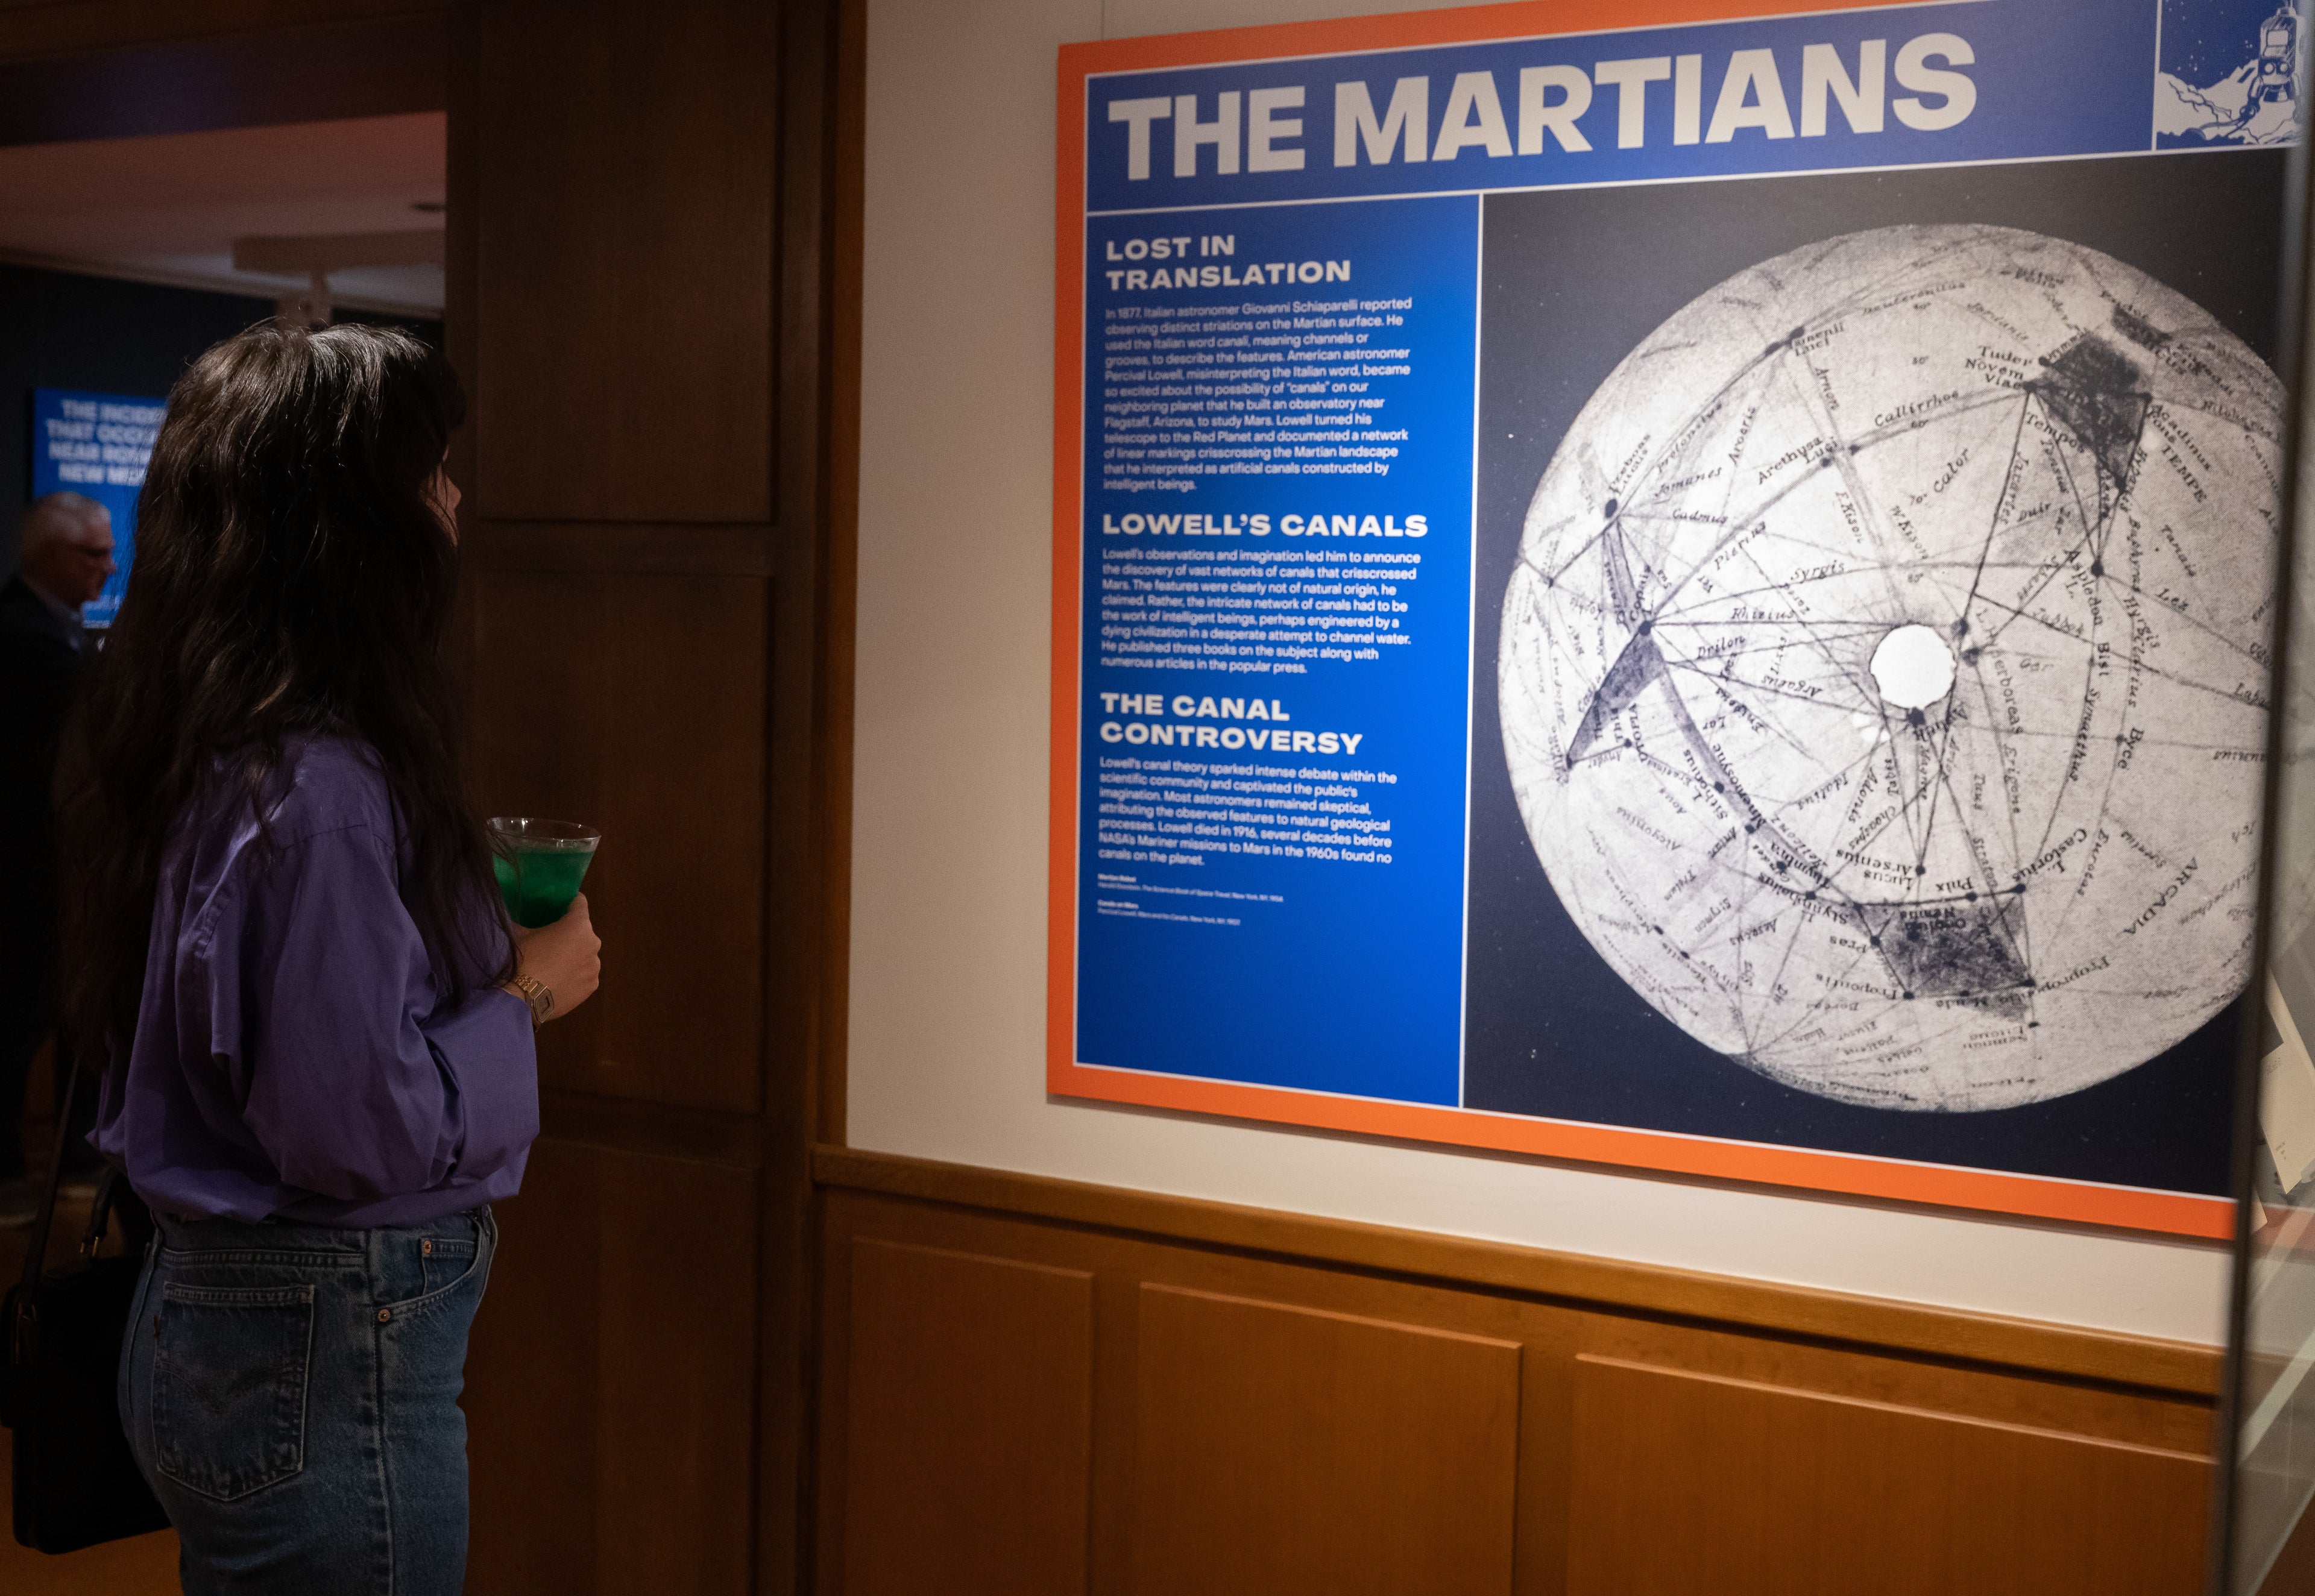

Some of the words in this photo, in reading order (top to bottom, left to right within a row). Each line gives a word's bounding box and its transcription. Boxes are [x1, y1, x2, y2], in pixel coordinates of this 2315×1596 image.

[1109, 86, 1306, 181] THE
[1334, 33, 1977, 169] MARTIANS
[1106, 236, 1191, 262] LOST
[1200, 234, 1235, 257] IN
[1106, 260, 1351, 291] TRANSLATION
[1292, 298, 1358, 315] Schiaparelli
[1359, 297, 1413, 313] reported
[1293, 316, 1337, 329] Martian
[1385, 313, 1404, 326] He
[1302, 331, 1355, 345] channels
[1287, 348, 1342, 362] American
[1341, 347, 1411, 360] astronomer
[1271, 366, 1292, 378] the
[1292, 365, 1328, 378] Italian
[1361, 363, 1411, 376] became
[1331, 382, 1348, 393] on
[1347, 382, 1369, 392] our
[1287, 397, 1358, 412] observatory
[1358, 398, 1385, 409] near
[1275, 413, 1313, 426] Lowell
[1313, 412, 1353, 425] turned
[1353, 412, 1373, 424] his
[1276, 429, 1350, 442] documented
[1360, 429, 1409, 441] network
[1272, 445, 1293, 457] the
[1293, 445, 1338, 457] Martian
[1338, 445, 1399, 459] landscape
[1264, 462, 1301, 473] canals
[1301, 461, 1373, 473] constructed
[1373, 461, 1390, 476] by
[2161, 445, 2206, 503] TEMPE
[1672, 509, 1728, 524] Cadmus
[1103, 514, 1271, 536] LOWELL'S
[1280, 515, 1428, 538] CANALS
[1238, 549, 1304, 564] imagination
[1305, 550, 1324, 562] led
[1324, 550, 1347, 562] him
[1348, 550, 1362, 562] to
[1362, 553, 1421, 564] announce
[1212, 564, 1264, 577] networks
[1264, 565, 1277, 577] of
[1278, 565, 1315, 577] canals
[1316, 566, 1340, 578] that
[1341, 567, 1417, 579] crisscrossed
[1229, 580, 1267, 595] clearly
[1267, 581, 1287, 593] not
[1288, 582, 1302, 594] of
[1302, 582, 1342, 594] natural
[1381, 583, 1397, 595] he
[1206, 595, 1253, 608] intricate
[1253, 596, 1300, 609] network
[1300, 597, 1314, 609] of
[1314, 598, 1352, 610] canals
[1352, 598, 1376, 611] had
[1376, 599, 1390, 611] to
[1391, 599, 1408, 612] be
[1258, 612, 1306, 627] perhaps
[1306, 614, 1374, 629] engineered
[1375, 615, 1391, 630] by
[1209, 627, 1267, 642] desperate
[1267, 628, 1313, 644] attempt
[1314, 630, 1328, 642] to
[1328, 630, 1375, 643] channel
[1238, 645, 1254, 655] on
[1255, 644, 1274, 656] the
[1275, 644, 1318, 660] subject
[1319, 646, 1352, 661] along
[1353, 647, 1379, 659] with
[1699, 636, 1745, 658] Drilon
[1228, 659, 1271, 674] popular
[1101, 692, 1164, 715] THE
[1171, 695, 1290, 721] CANAL
[1100, 721, 1362, 755] CONTROVERSY
[1630, 703, 1648, 762] UTOPIA
[2117, 727, 2143, 770] Byce
[1172, 759, 1208, 775] theory
[1209, 761, 1254, 778] sparked
[1255, 764, 1297, 778] intense
[1297, 766, 1340, 780] debate
[1340, 768, 1376, 782] within
[1377, 770, 1397, 783] the
[1210, 777, 1232, 790] and
[1232, 778, 1292, 795] captivated
[1293, 781, 1313, 794] the
[1848, 768, 1879, 822] Adonis
[1192, 791, 1262, 807] astronomers
[1263, 796, 1317, 810] remained
[1660, 788, 1687, 814] Aous
[1175, 806, 1228, 820] observed
[1228, 809, 1275, 823] features
[1276, 812, 1289, 824] to
[1290, 812, 1329, 827] natural
[1329, 815, 1390, 833] geological
[1193, 823, 1220, 835] died
[1220, 825, 1232, 837] in
[1259, 827, 1300, 841] several
[1301, 829, 1352, 844] decades
[1352, 833, 1392, 847] before
[1179, 837, 1227, 852] missions
[1229, 840, 1242, 853] to
[1242, 841, 1271, 855] Mars
[1271, 843, 1283, 855] in
[1284, 844, 1304, 857] the
[1305, 846, 1340, 859] 1960s
[1340, 848, 1375, 862] found
[1376, 852, 1393, 863] no
[2013, 828, 2087, 881] Castorius
[1836, 849, 1913, 875] Arsenius
[1863, 872, 1913, 890] Lucus
[2124, 857, 2198, 935] ARCADIA
